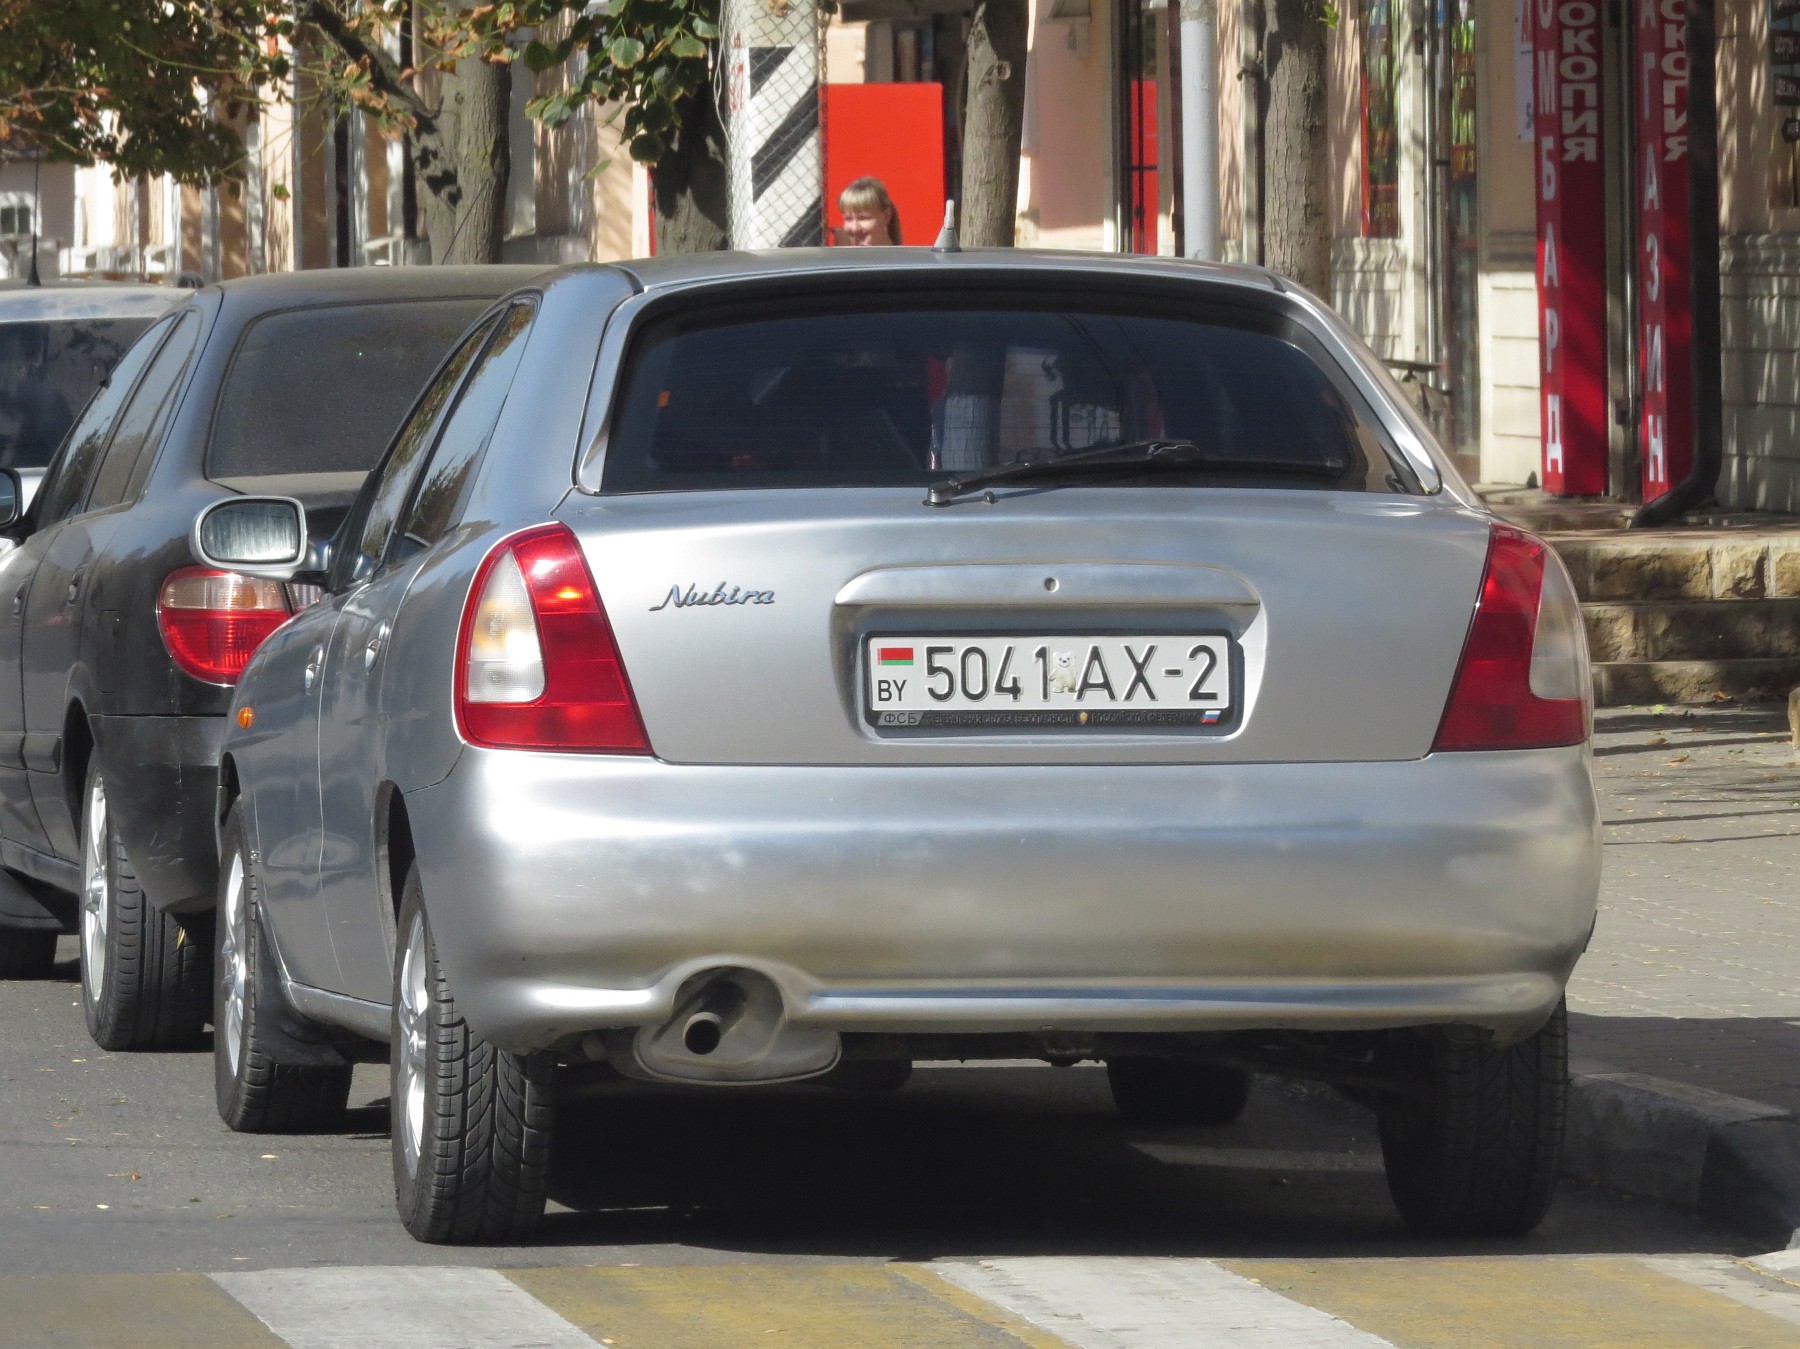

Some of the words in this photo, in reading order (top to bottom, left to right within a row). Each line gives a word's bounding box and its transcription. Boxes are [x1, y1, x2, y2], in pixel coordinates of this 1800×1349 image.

[648, 581, 775, 611] Nubira
[925, 645, 1050, 701] 5041
[1076, 644, 1219, 700] AX-2
[877, 679, 907, 702] BY
[884, 712, 917, 724] ФСБ
